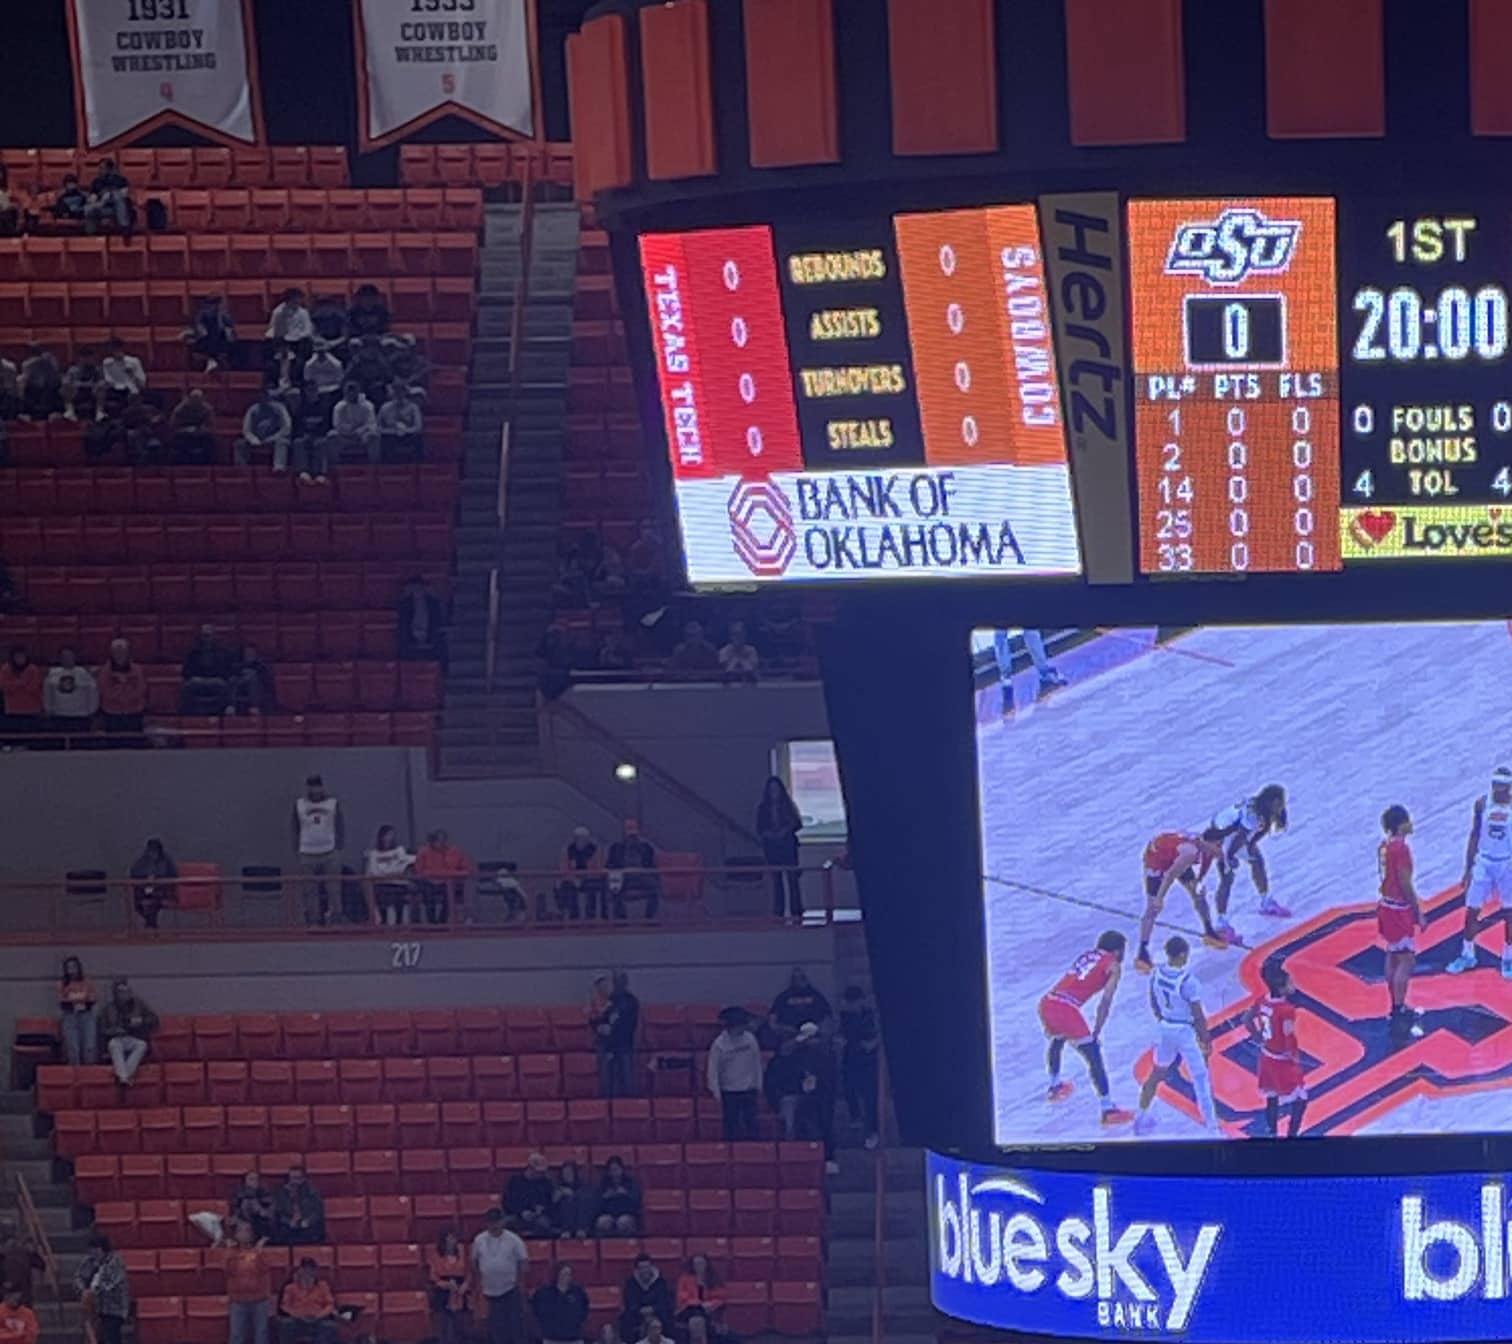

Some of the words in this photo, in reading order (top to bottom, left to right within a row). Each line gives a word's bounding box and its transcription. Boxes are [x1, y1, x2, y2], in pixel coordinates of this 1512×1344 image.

[116, 30, 204, 49] COWBOY
[401, 22, 486, 41] COWBOY
[112, 53, 216, 72] WRESTLING
[395, 45, 498, 62] WRESTLING
[1387, 219, 1475, 261] 1ST
[723, 260, 739, 291] 0
[788, 249, 886, 283] REBOUNDS
[939, 244, 956, 276] 0
[731, 317, 747, 348] 0
[811, 310, 880, 340] ASSISTS
[947, 303, 964, 335] 0
[1001, 245, 1056, 426] COWBOYS
[1054, 208, 1122, 444] Hertz
[1224, 302, 1249, 358] 0
[1352, 287, 1507, 360] 20:00
[653, 266, 689, 372] TEXAS
[671, 382, 702, 465] TECH
[739, 373, 755, 404] 0
[800, 365, 905, 397] TURNOVERS
[954, 360, 971, 392] 0
[1149, 375, 1195, 399] PL#
[1214, 374, 1260, 398] PTS
[1280, 374, 1322, 397] FLS
[1168, 411, 1181, 434] 1
[1227, 408, 1244, 434] 0
[1292, 408, 1310, 434] 0
[1353, 407, 1373, 433] 0
[1392, 406, 1474, 433] FOULS
[1493, 404, 1512, 431] 0
[747, 425, 763, 456] 0
[827, 420, 893, 449] STEALS
[961, 416, 978, 447] 0
[1390, 438, 1476, 463] BONUS
[1163, 444, 1182, 469] 2
[1228, 442, 1245, 468] 0
[1293, 441, 1311, 468] 0
[797, 478, 900, 520] BANK
[909, 472, 958, 518] OF
[1158, 478, 1193, 503] 14
[1229, 476, 1246, 503] 0
[1294, 475, 1312, 502] 0
[1353, 471, 1375, 497] 4
[1408, 470, 1459, 495] TOL
[1491, 469, 1512, 495] 4
[1157, 511, 1193, 538] 25
[1230, 509, 1248, 536] 0
[1295, 508, 1313, 536] 0
[804, 520, 1026, 569] OKLAHOMA
[1158, 545, 1194, 571] 33
[1231, 544, 1249, 570] 0
[1296, 542, 1313, 569] 0
[391, 942, 420, 967] 217
[1097, 1303, 1161, 1330] BANK
